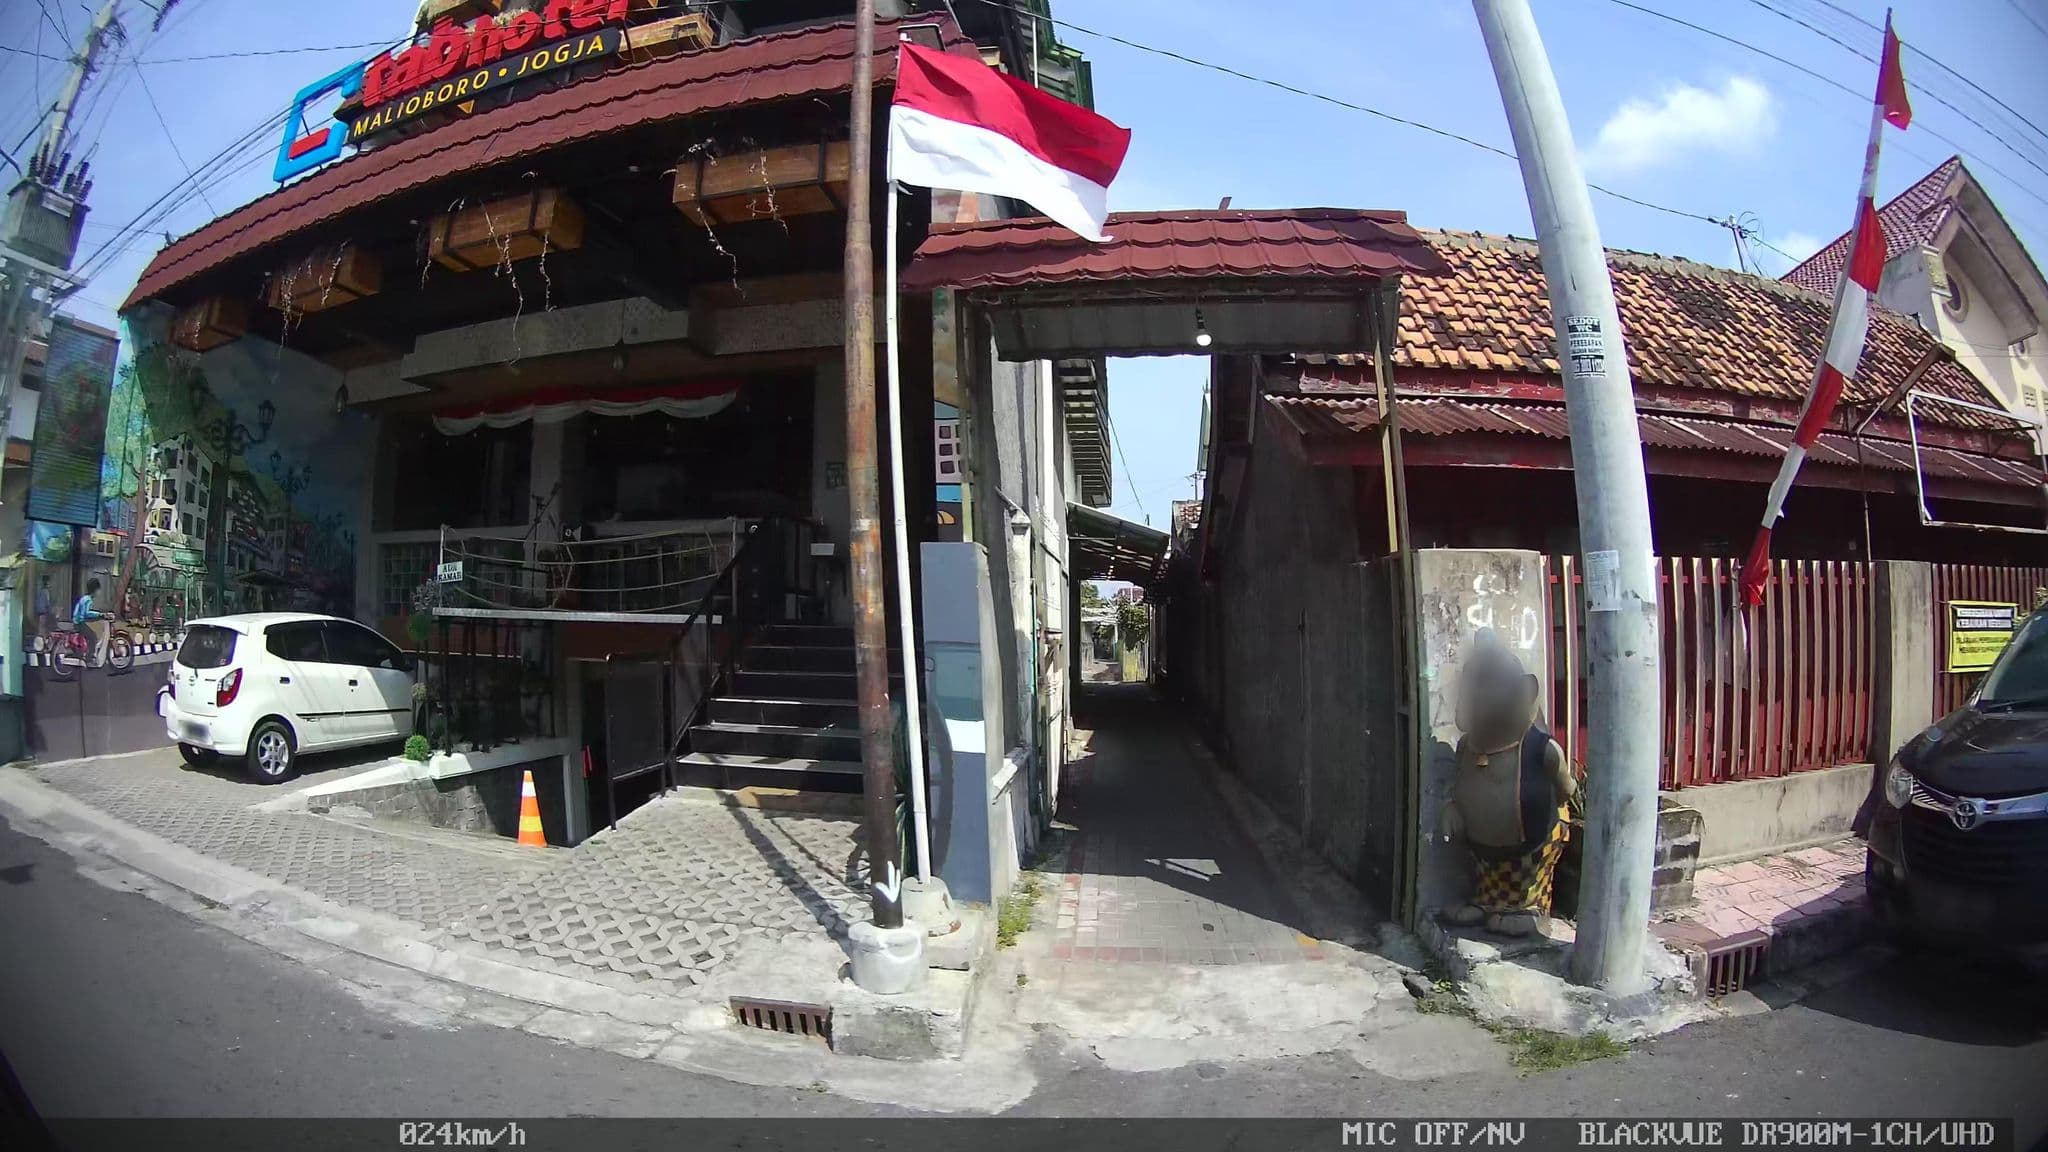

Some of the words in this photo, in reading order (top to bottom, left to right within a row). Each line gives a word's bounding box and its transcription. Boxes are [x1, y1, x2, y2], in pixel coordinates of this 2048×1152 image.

[353, 70, 490, 138] MALIOBORO
[517, 34, 604, 76] JOGJA
[1568, 318, 1599, 326] SEDOT
